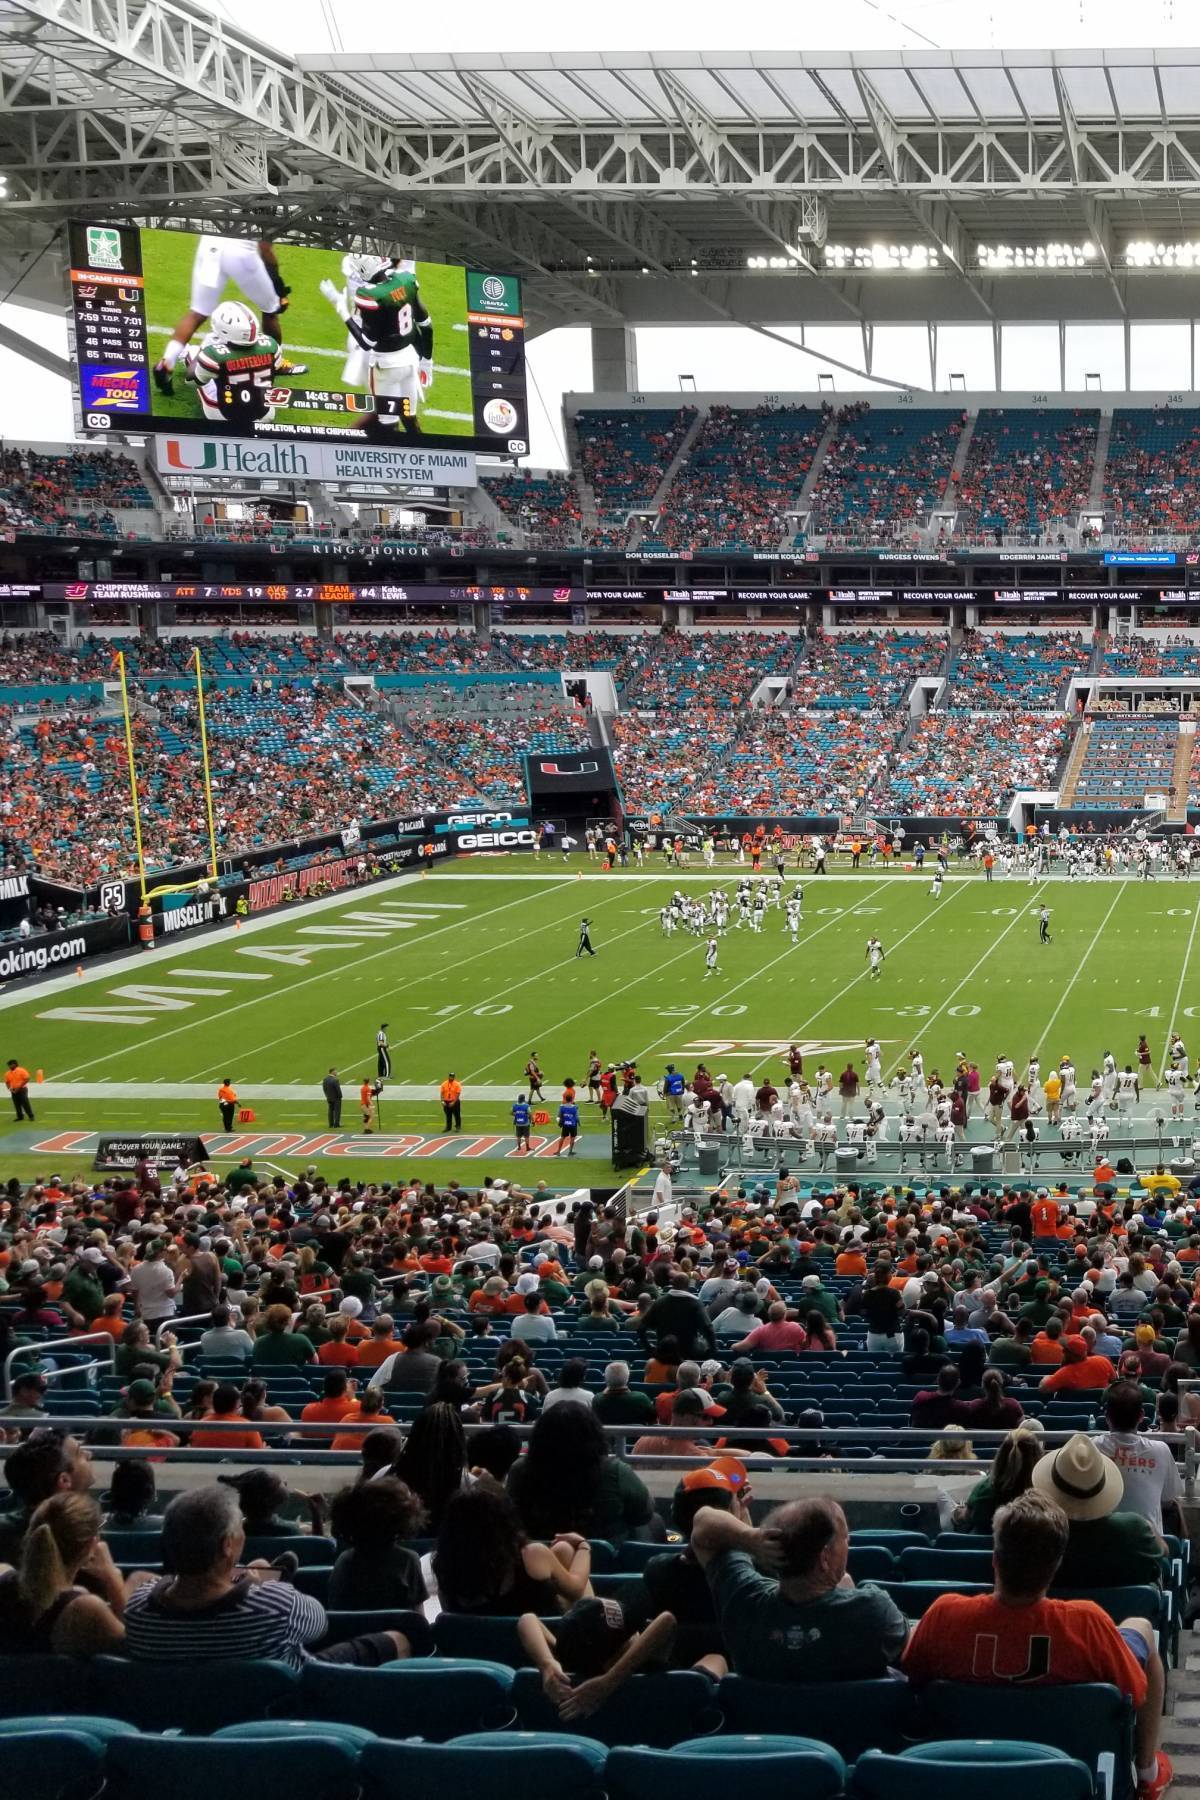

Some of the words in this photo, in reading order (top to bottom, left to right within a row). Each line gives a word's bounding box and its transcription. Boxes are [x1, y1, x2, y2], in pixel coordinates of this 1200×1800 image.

[86, 301, 92, 309] 5
[129, 305, 136, 313] 4
[78, 312, 99, 321] 7:59
[123, 316, 142, 326] 7:01
[398, 304, 413, 336] 8
[86, 325, 97, 333] 19
[101, 326, 121, 334] RUSH
[129, 329, 141, 337] 27
[86, 337, 98, 346] 46
[102, 338, 122, 347] PASS
[128, 341, 143, 350] 101
[103, 351, 125, 360] TOTAL
[128, 353, 144, 362] 128
[91, 377, 138, 390] MECHA
[106, 388, 139, 400] TOOL
[305, 390, 329, 401] 14:43
[1031, 395, 1048, 404] 344
[1167, 395, 1183, 404] 345
[631, 396, 646, 404] 341
[763, 396, 779, 404] 342
[897, 396, 913, 404] 343
[90, 415, 109, 427] CC
[510, 442, 525, 452] CC
[335, 449, 408, 465] UNIVERSITY
[409, 453, 425, 466] OF
[428, 455, 467, 468] MIAMI
[336, 466, 382, 479] HEALTH
[385, 467, 434, 481] SYSTEM
[312, 545, 355, 555] RING
[370, 546, 429, 556] HONOR
[780, 553, 806, 561] KOSAR
[879, 553, 912, 561] BURGESS
[913, 553, 940, 561] OWENS
[95, 584, 149, 592] CHIPPEWAS
[175, 587, 196, 596] ATT
[221, 588, 242, 597] YDS
[247, 588, 262, 598] 19
[295, 587, 313, 598] 2.7
[323, 585, 349, 593] TEAM
[360, 588, 375, 598] #4
[92, 591, 121, 599] TEAM
[121, 591, 161, 599] RUSHING
[320, 592, 355, 600] LEADER
[382, 592, 408, 600] LEWIS
[493, 593, 504, 601] 26
[1068, 592, 1097, 600] RECOVER
[1099, 592, 1118, 600] YOUR
[404, 818, 425, 832] BACARDÍ
[457, 830, 537, 849] GEICO
[163, 903, 204, 932] MUSCLE
[204, 897, 227, 920] MK
[0, 937, 86, 976] oking.com
[35, 901, 468, 1024] MIAMI
[428, 1004, 514, 1016] 10
[657, 1004, 749, 1016] 20
[897, 1004, 982, 1016] 30
[108, 1142, 140, 1151] RECOVER
[141, 1142, 160, 1151] YOUR
